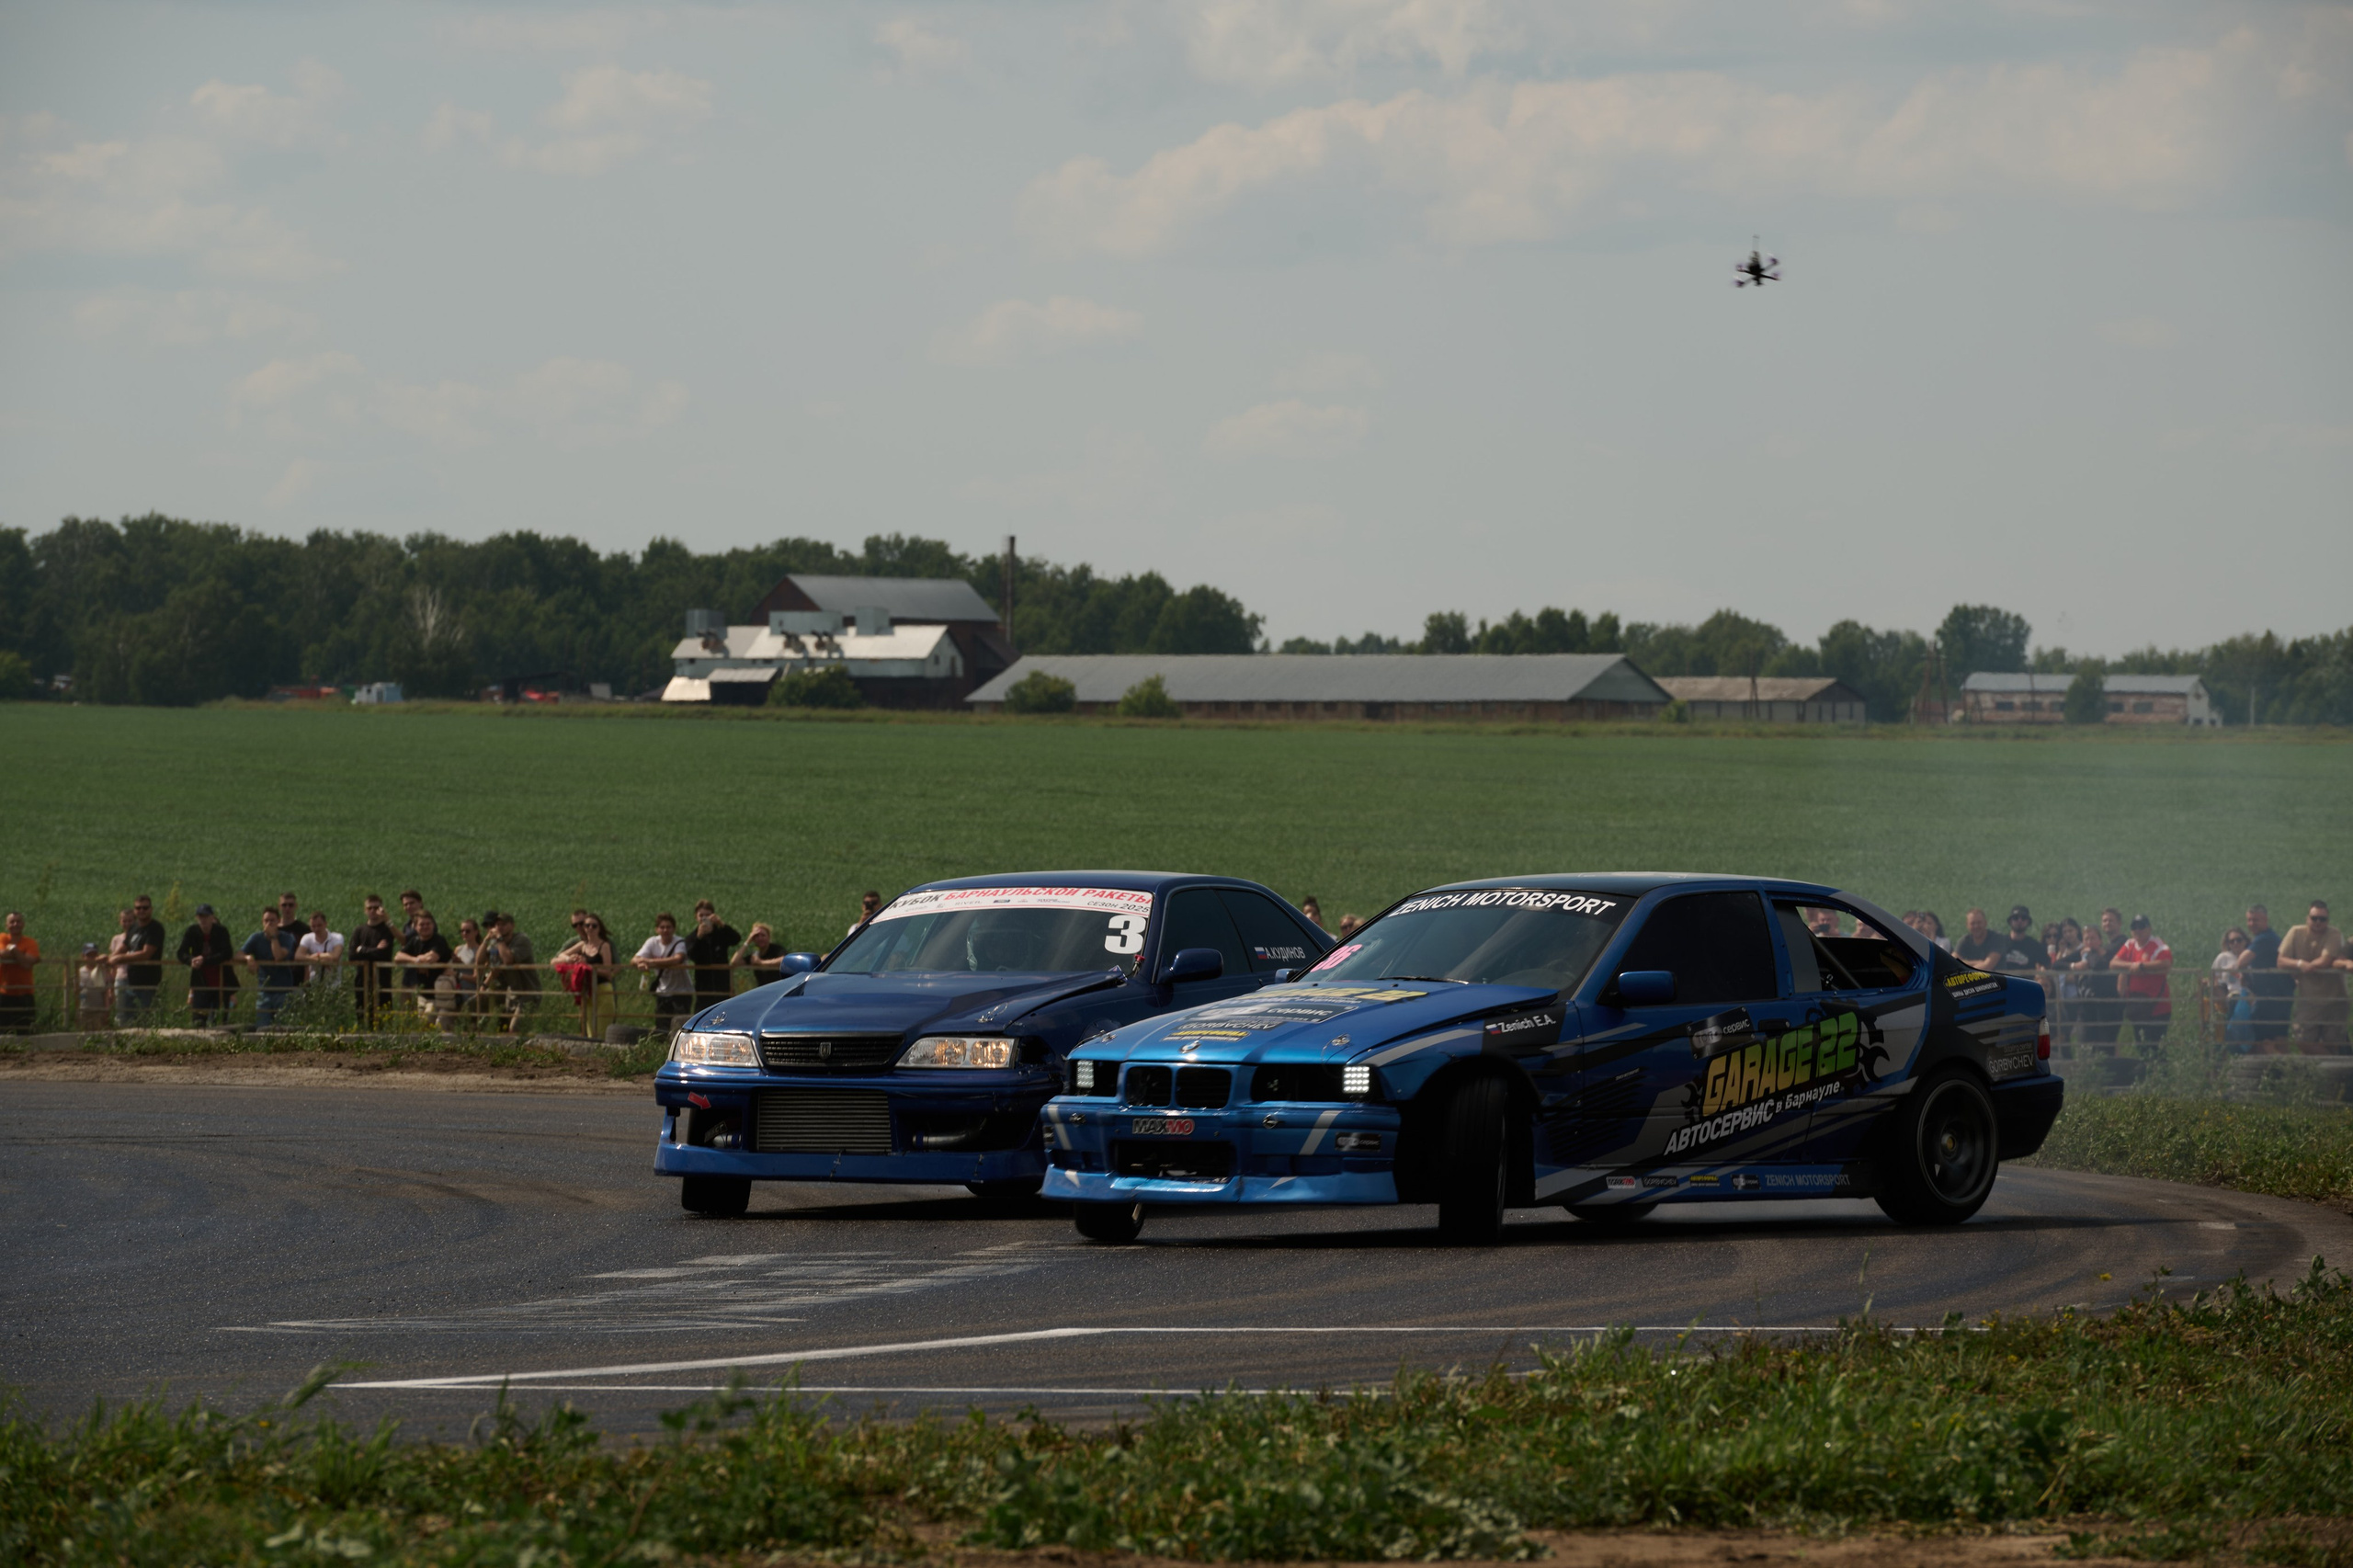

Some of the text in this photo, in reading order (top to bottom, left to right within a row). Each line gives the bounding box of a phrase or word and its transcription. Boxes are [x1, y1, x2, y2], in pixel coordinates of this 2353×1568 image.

[889, 894, 944, 909] КУБОК
[944, 887, 1081, 901] БАРНАУЛЬСКОЙ
[1082, 889, 1152, 903] РАКЕТЫ
[1120, 903, 1150, 913] 2025
[1388, 892, 1617, 917] ZENICH MOTORSPORT
[1105, 915, 1146, 954] 3
[1497, 1014, 1557, 1033] Zenich E.A.
[1722, 1018, 1751, 1036] сервис
[1702, 1011, 1859, 1117] GARAGE 22
[1664, 1081, 1841, 1156] АВТОСЕРВИС в Барнауле
[1765, 1174, 1851, 1187] ZENICH MOTORSPORT
